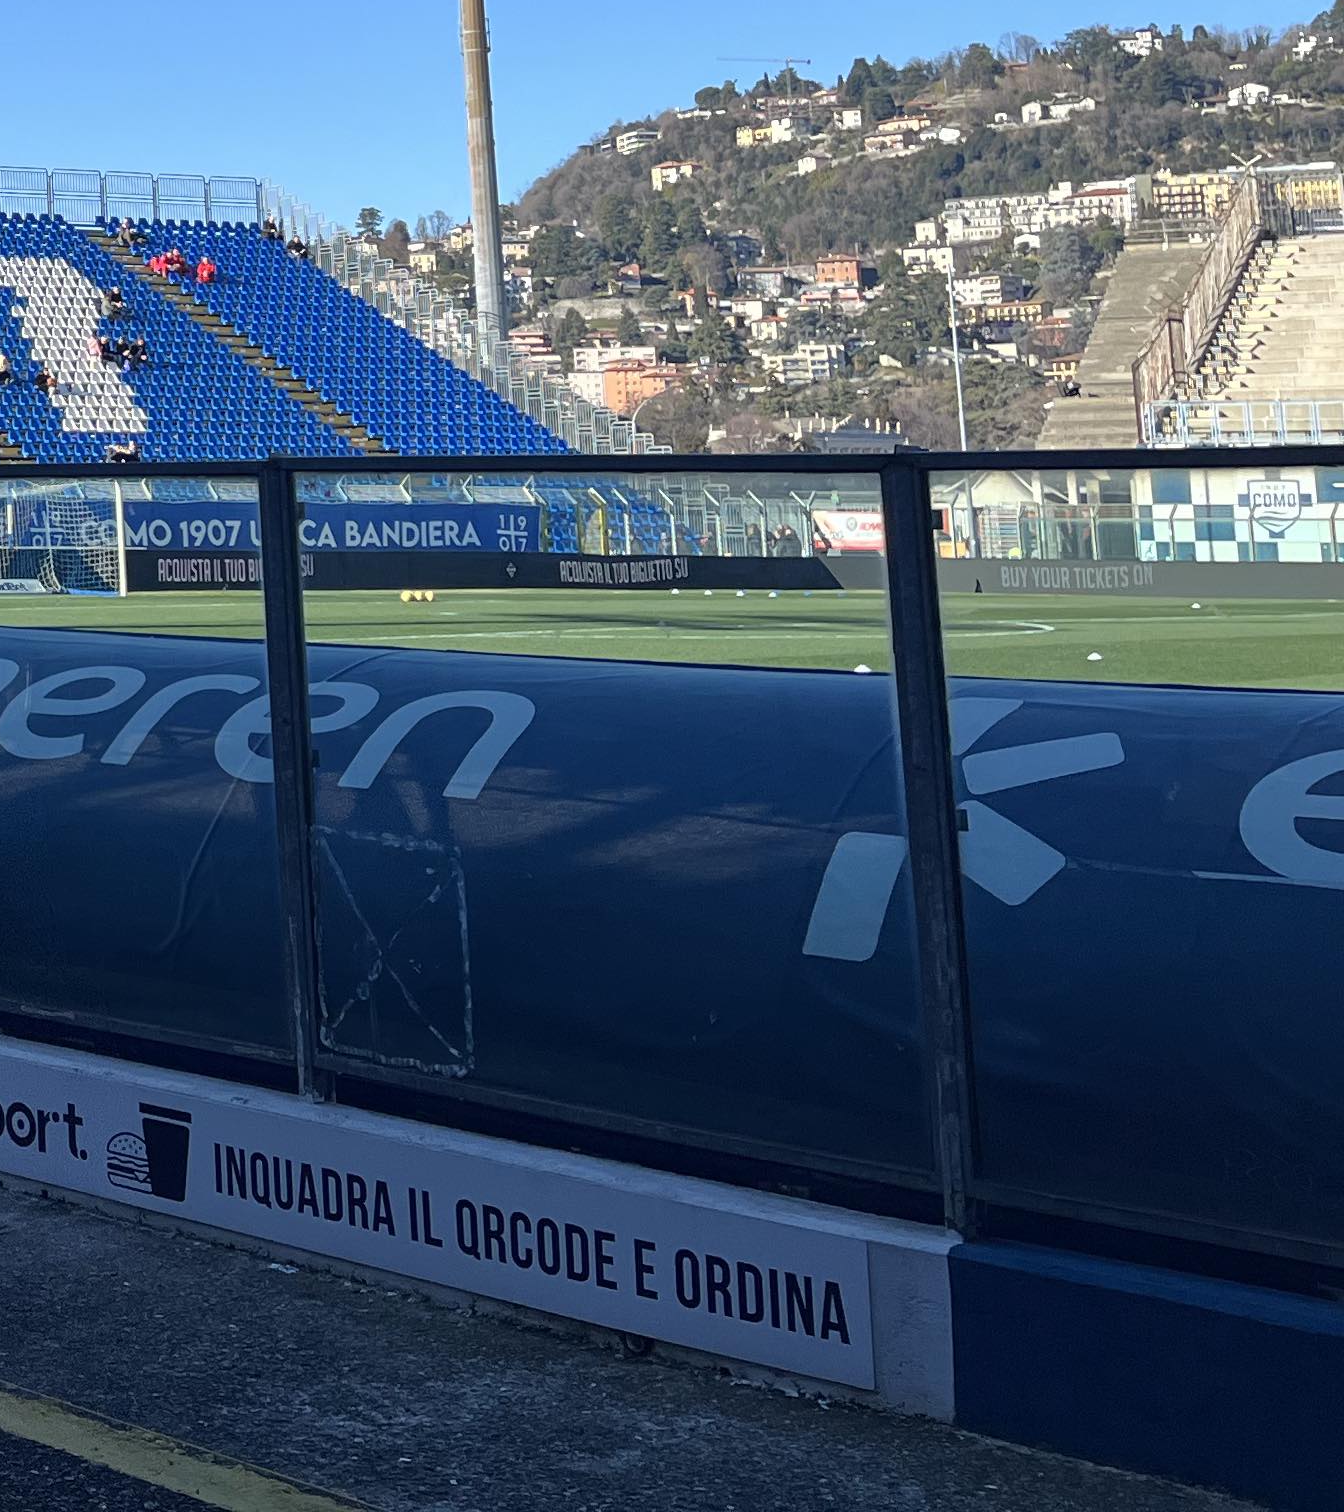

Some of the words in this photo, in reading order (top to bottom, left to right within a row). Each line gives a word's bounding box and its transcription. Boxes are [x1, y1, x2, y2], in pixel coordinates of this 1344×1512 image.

[1253, 493, 1297, 507] COMO
[180, 519, 242, 548] 1907
[251, 519, 338, 548] UCA
[345, 519, 481, 548] BANDIERA
[157, 558, 211, 583] ACQUISTA
[213, 558, 224, 582] IL
[224, 558, 246, 582] TUO
[300, 554, 314, 577] SU
[560, 560, 604, 584] ACQUISTA
[630, 558, 673, 584] BIGLIETTO
[674, 557, 689, 579] SU
[1000, 565, 1029, 588] BUY
[1031, 567, 1070, 589] YOUR
[1074, 565, 1129, 589] TICKETS
[1132, 563, 1153, 586] ON
[212, 1142, 396, 1236] INQUADRA
[408, 1187, 444, 1249] IL
[455, 1198, 618, 1291] QRCODE
[633, 1238, 659, 1301] E
[674, 1248, 852, 1346] ORDINA
